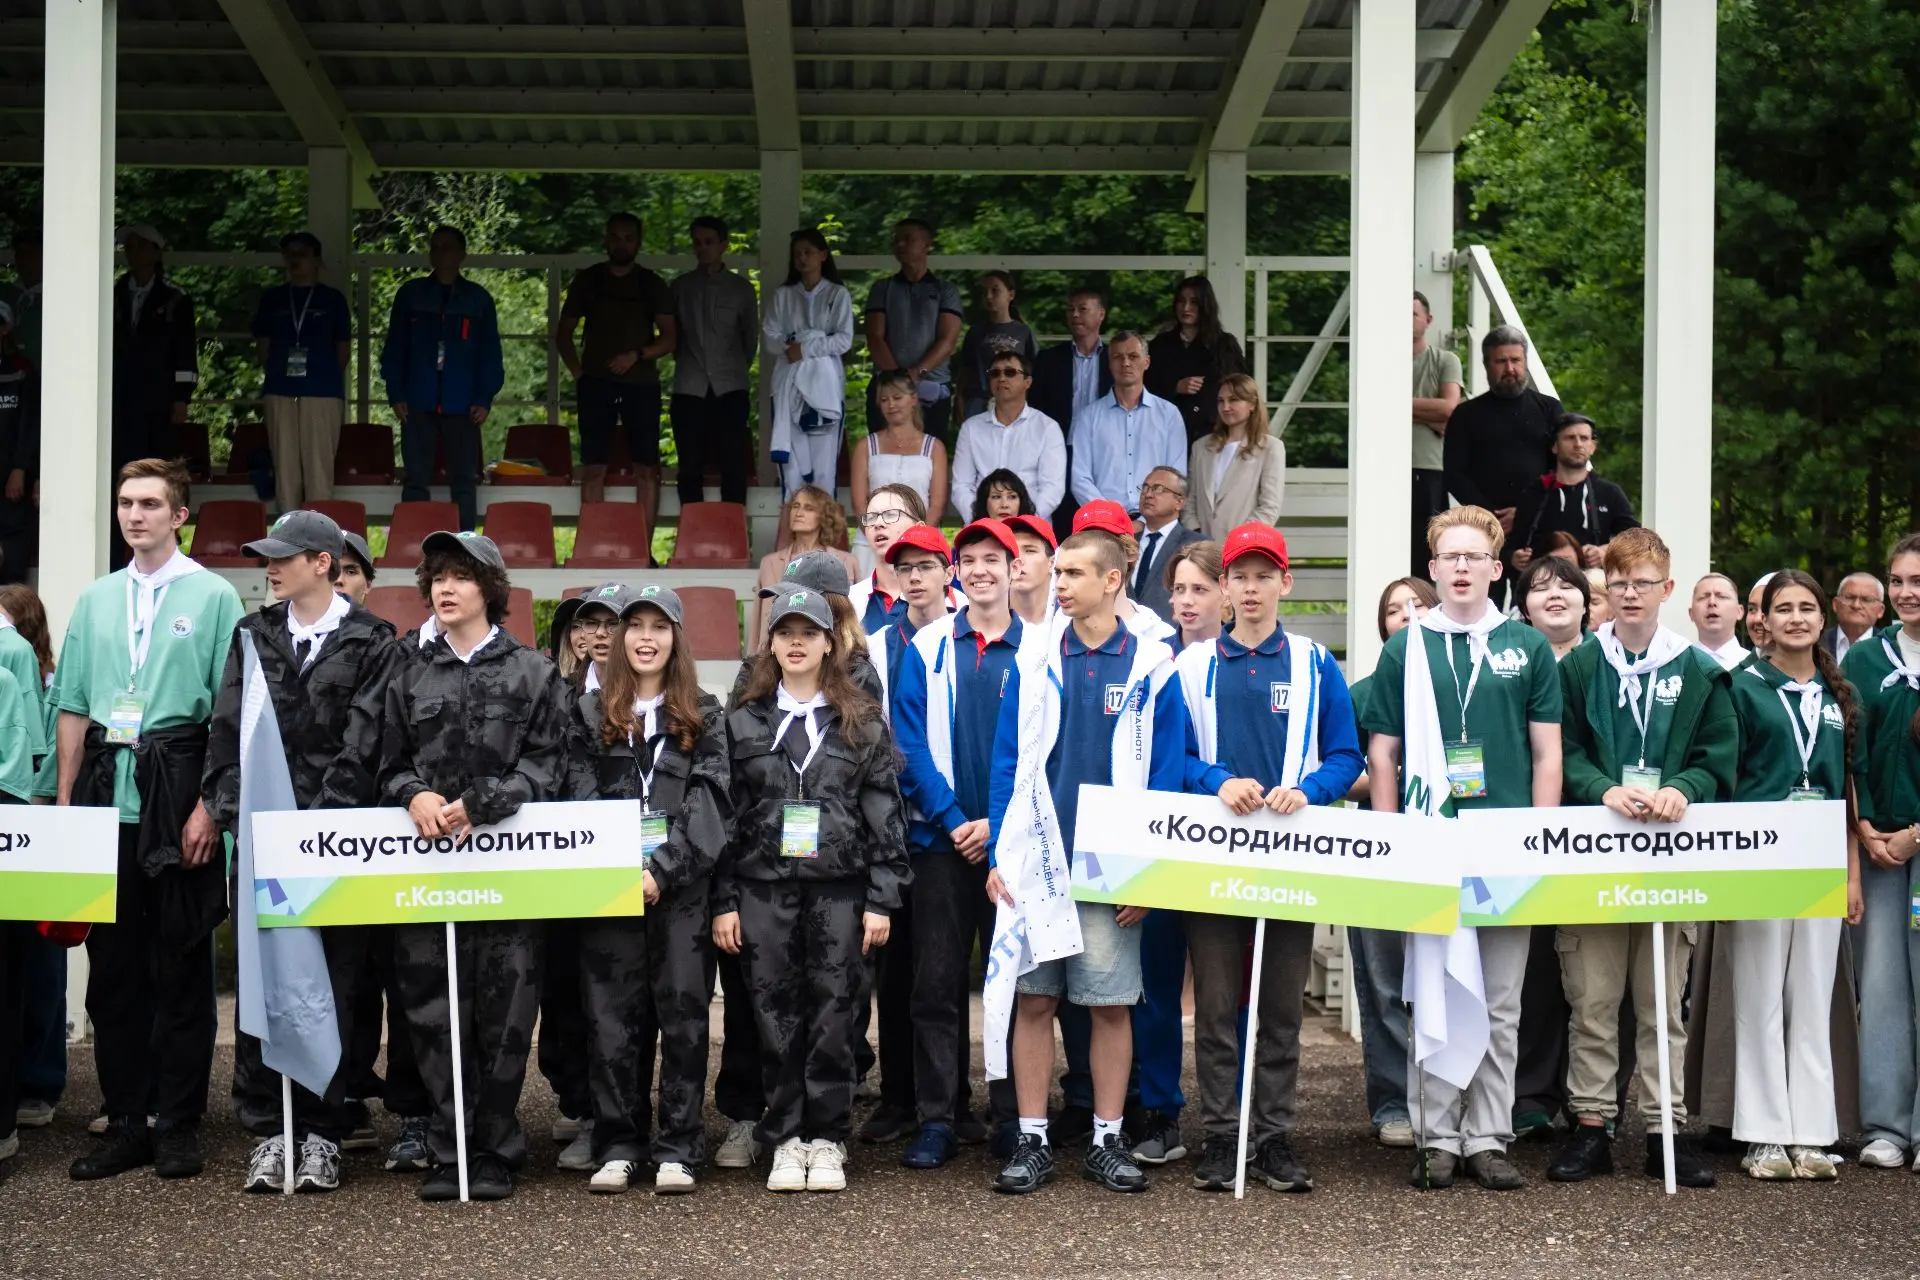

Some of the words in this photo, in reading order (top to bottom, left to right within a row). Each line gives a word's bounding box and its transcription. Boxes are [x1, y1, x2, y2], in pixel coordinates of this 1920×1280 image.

[1110, 691, 1124, 707] 17
[1276, 689, 1289, 706] 17
[1148, 814, 1392, 859] «Координата»
[1523, 827, 1779, 857] «Мастодонты»
[1038, 829, 1057, 898] УЧРЕЖДЕНИЕ
[395, 885, 504, 908] г.Казань
[1209, 877, 1318, 907] г.Казань
[1597, 884, 1709, 907] г.Казань
